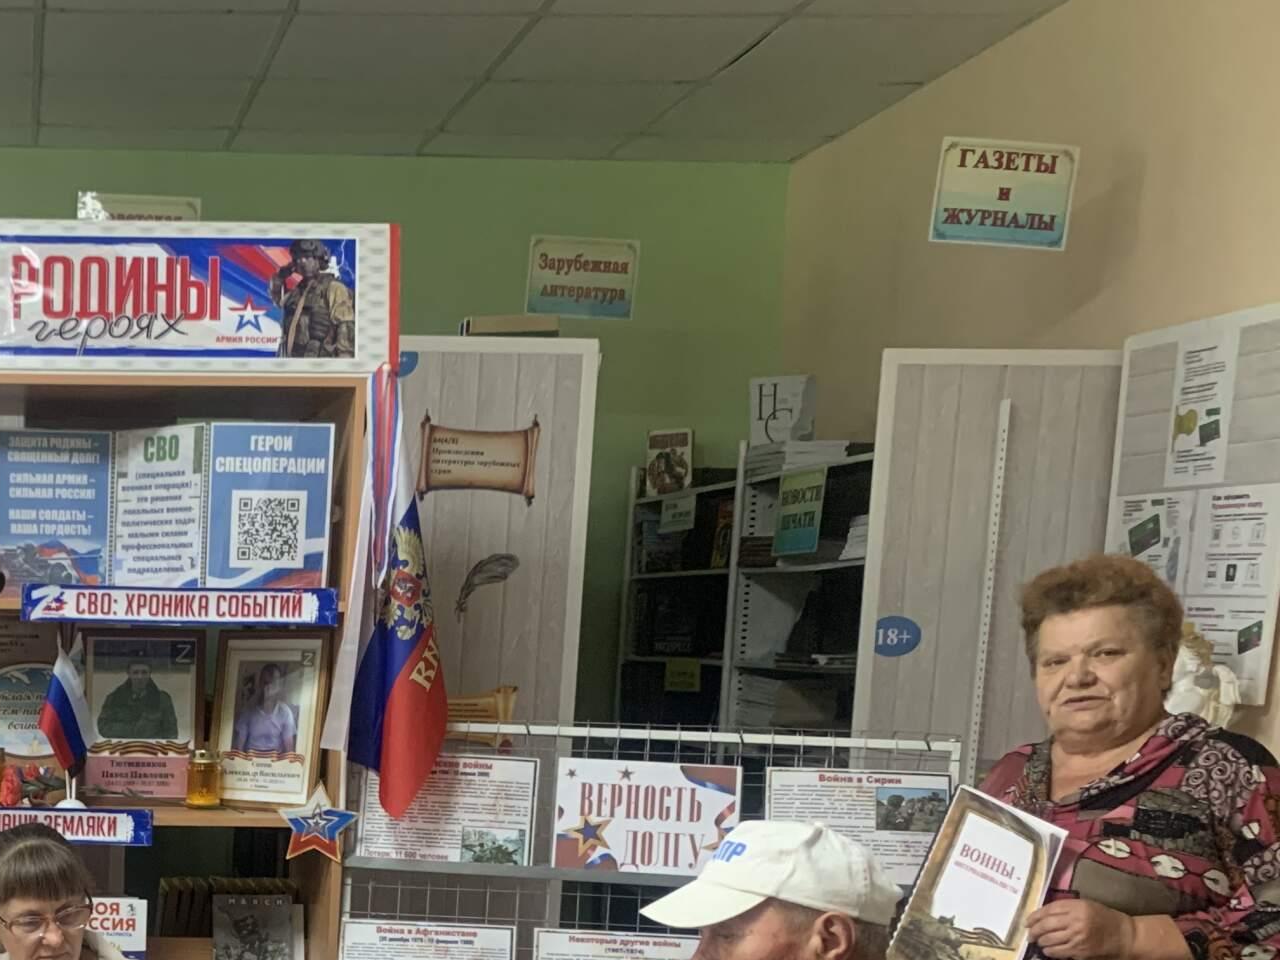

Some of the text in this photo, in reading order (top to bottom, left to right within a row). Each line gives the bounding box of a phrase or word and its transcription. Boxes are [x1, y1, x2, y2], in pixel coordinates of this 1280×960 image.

[957, 148, 1059, 174] ГАЗЕТЫ
[942, 207, 1057, 231] ЖУРНАЛЫ
[538, 252, 630, 275] Зарубежная
[12, 253, 221, 322] РОДИНЫ
[27, 312, 189, 358] героях
[215, 335, 243, 344] АРМИЯ
[143, 434, 180, 463] СВО
[249, 435, 293, 452] ГЕРОИ
[215, 457, 325, 476] СПЕЦОПЕРАЦИИ
[9, 472, 88, 485] СИЛЬНАЯ АРМИЯ
[8, 487, 54, 499] СИЛЬНАЯ
[8, 508, 87, 522] НАШИ СОЛДАТЫ
[10, 523, 38, 535] НАША
[75, 589, 303, 618] СВО: ХРОНИКА СОБЫТИЙ
[876, 627, 912, 646] 18+
[818, 773, 854, 783] Война
[866, 775, 902, 785] Сирии
[579, 782, 703, 823] ВЕРНОСТЬ
[621, 830, 706, 871] ДОЛГУ
[95, 902, 120, 915] ОЯ
[89, 917, 136, 931] ССИЯ
[376, 925, 405, 935] Война
[413, 926, 478, 938] Афганистане
[568, 935, 617, 945] Некоторые
[619, 937, 650, 948] другие
